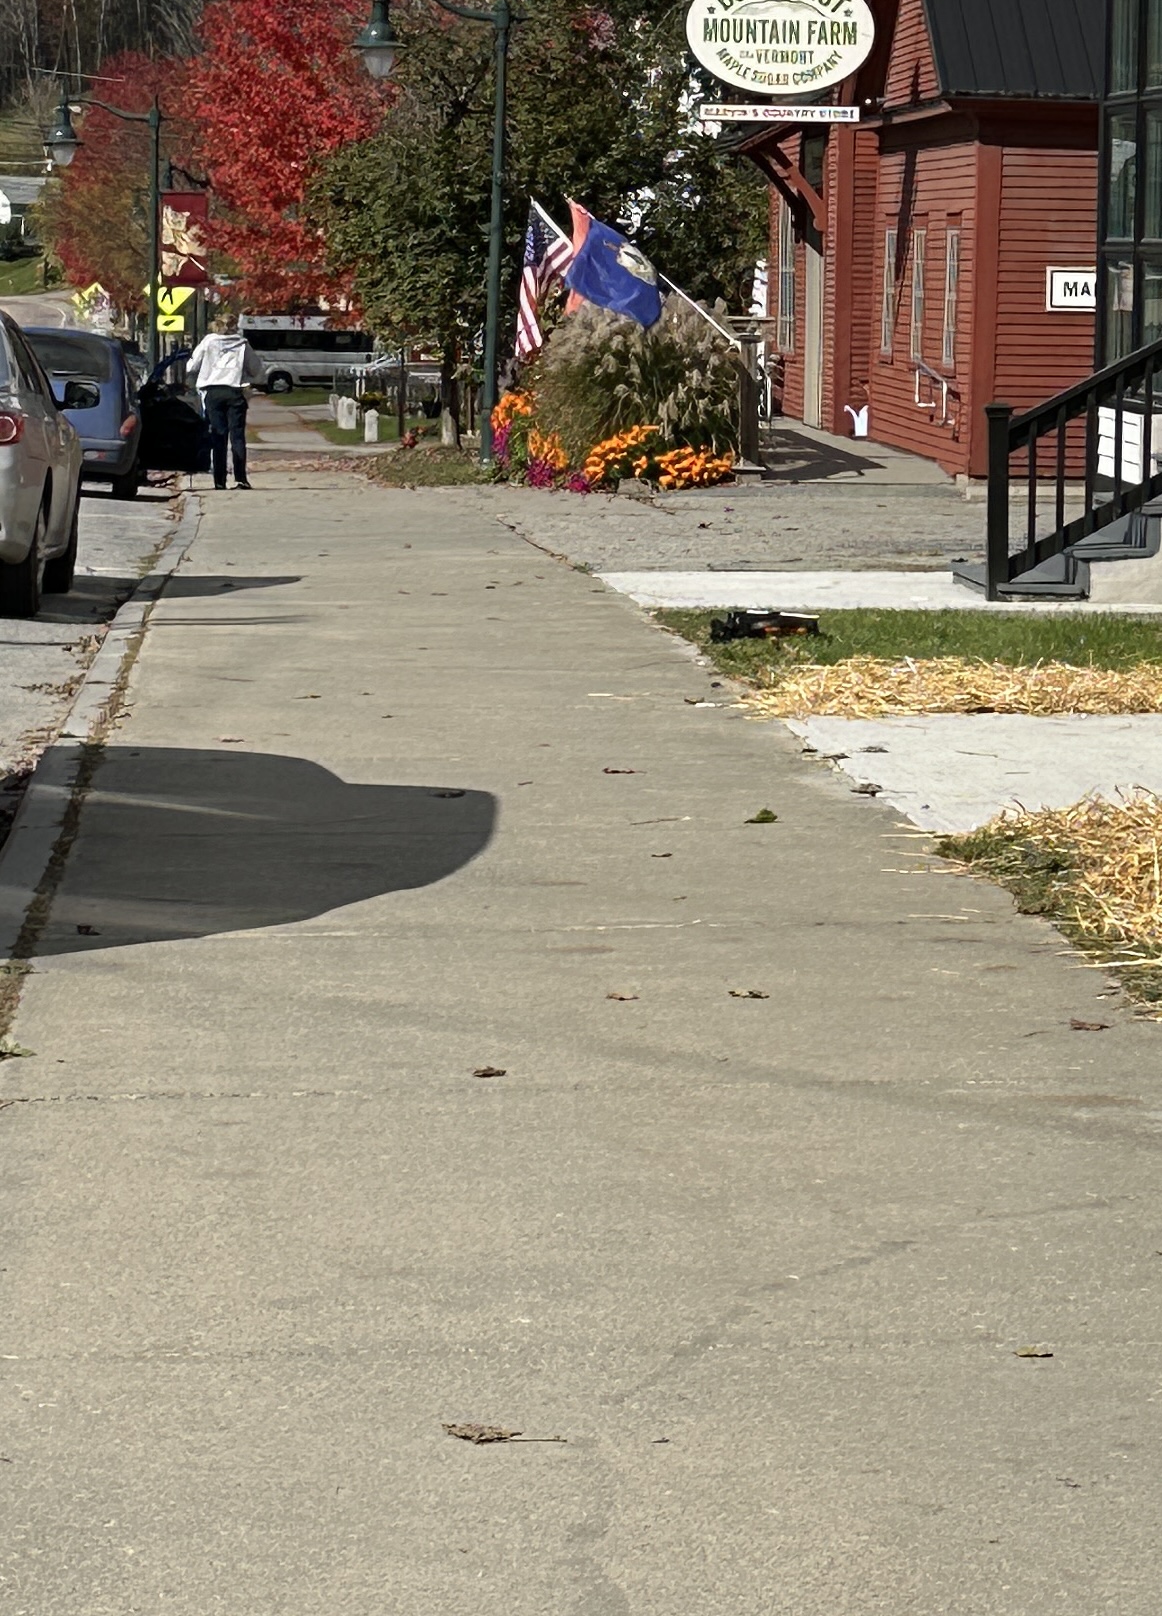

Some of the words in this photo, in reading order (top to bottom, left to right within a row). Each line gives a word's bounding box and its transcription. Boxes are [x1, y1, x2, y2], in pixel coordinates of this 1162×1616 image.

[703, 17, 800, 45] MOUNTAIN
[807, 20, 858, 46] FARM
[716, 47, 752, 79] MAPLE
[756, 48, 815, 65] VERMONT
